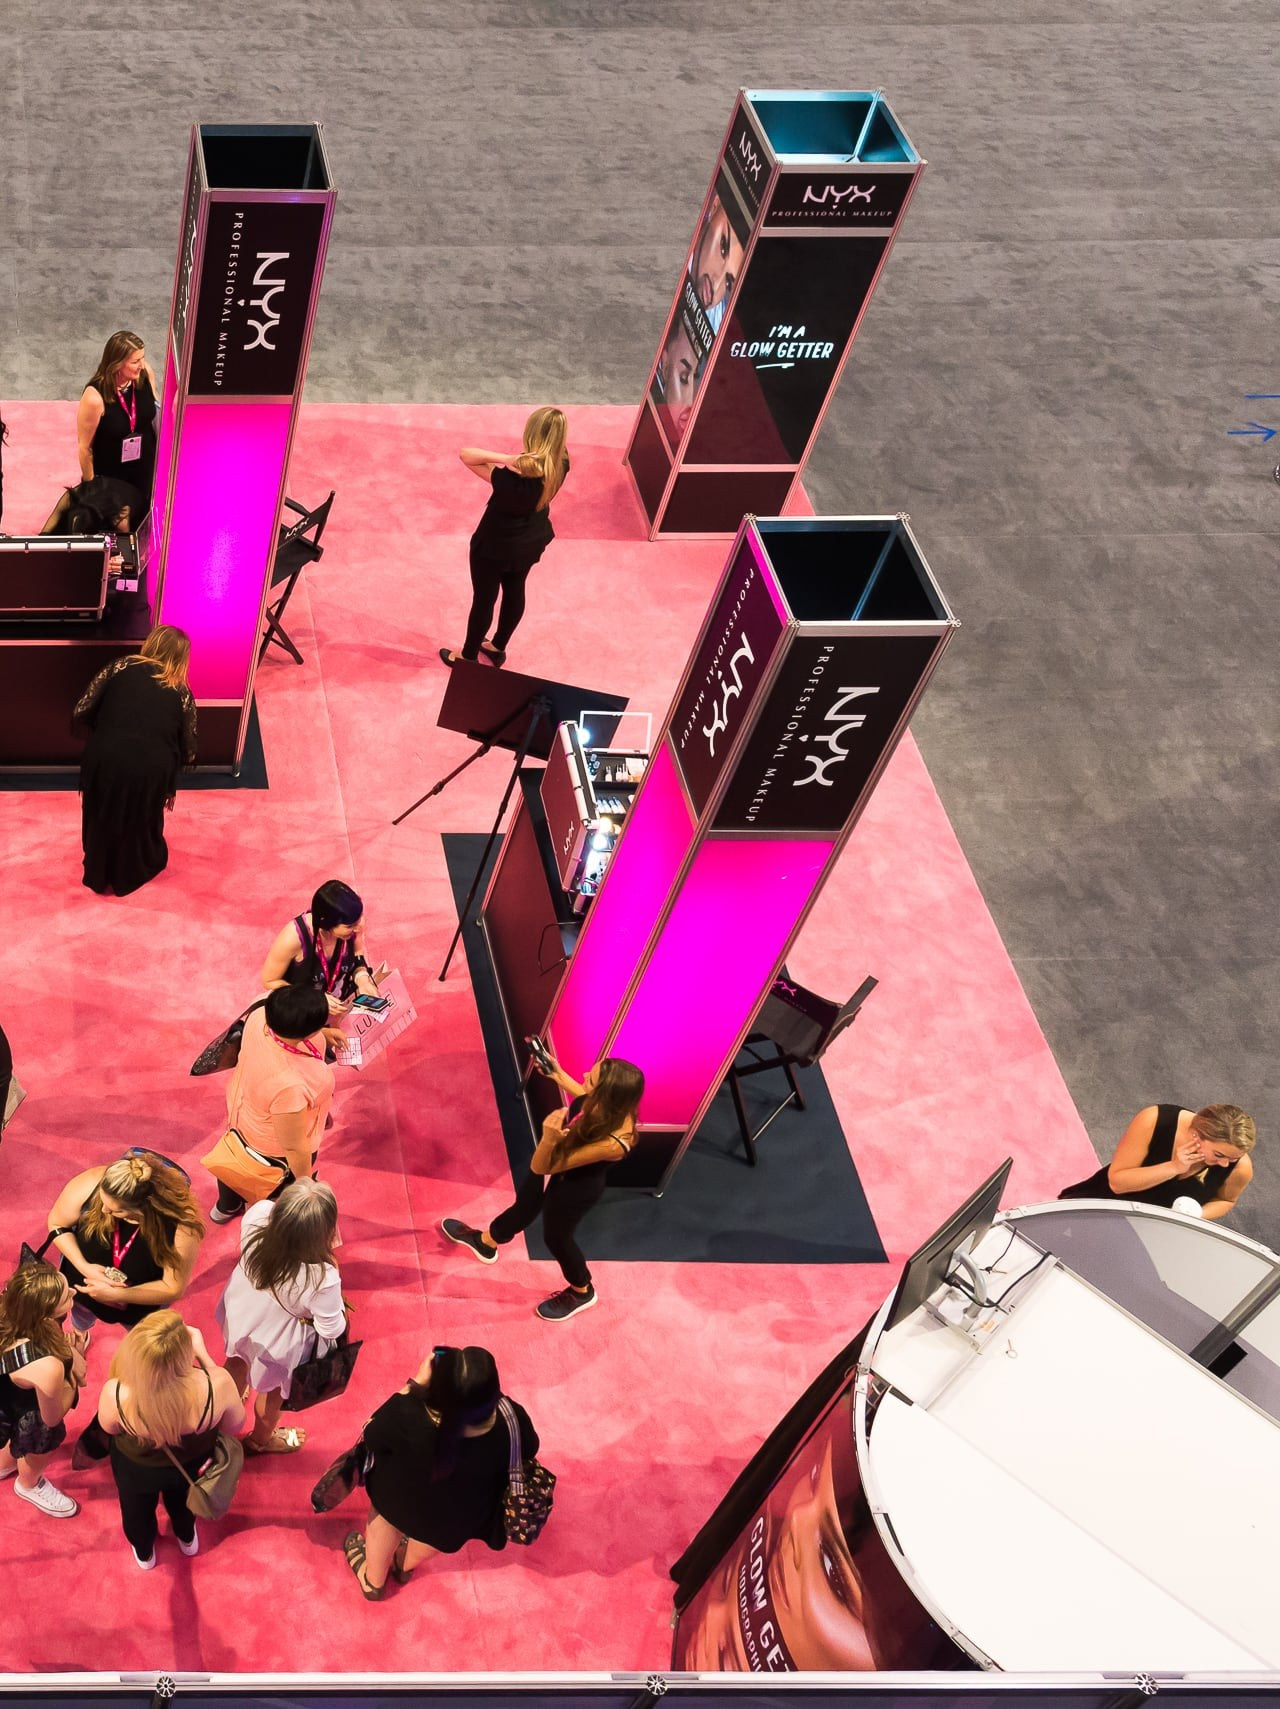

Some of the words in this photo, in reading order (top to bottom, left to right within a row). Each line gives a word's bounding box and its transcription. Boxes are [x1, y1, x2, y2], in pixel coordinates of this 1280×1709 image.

[739, 131, 762, 182] NYX
[802, 185, 876, 203] NYX
[221, 212, 244, 323] PROFESSIONAL
[243, 252, 290, 350] NYX
[213, 332, 229, 386] MAKEUP
[730, 341, 776, 358] GLOW
[777, 341, 835, 359] GETTER
[768, 325, 793, 339] I'M
[793, 325, 806, 339] A
[705, 568, 755, 685] PROFESSIONAL
[680, 690, 706, 749] MAKEUP
[702, 632, 755, 758] NYX
[772, 645, 835, 760] PROFESSIONAL
[792, 686, 881, 787] NYX
[745, 768, 778, 822] MAKEUP
[749, 1516, 768, 1613] GLOW
